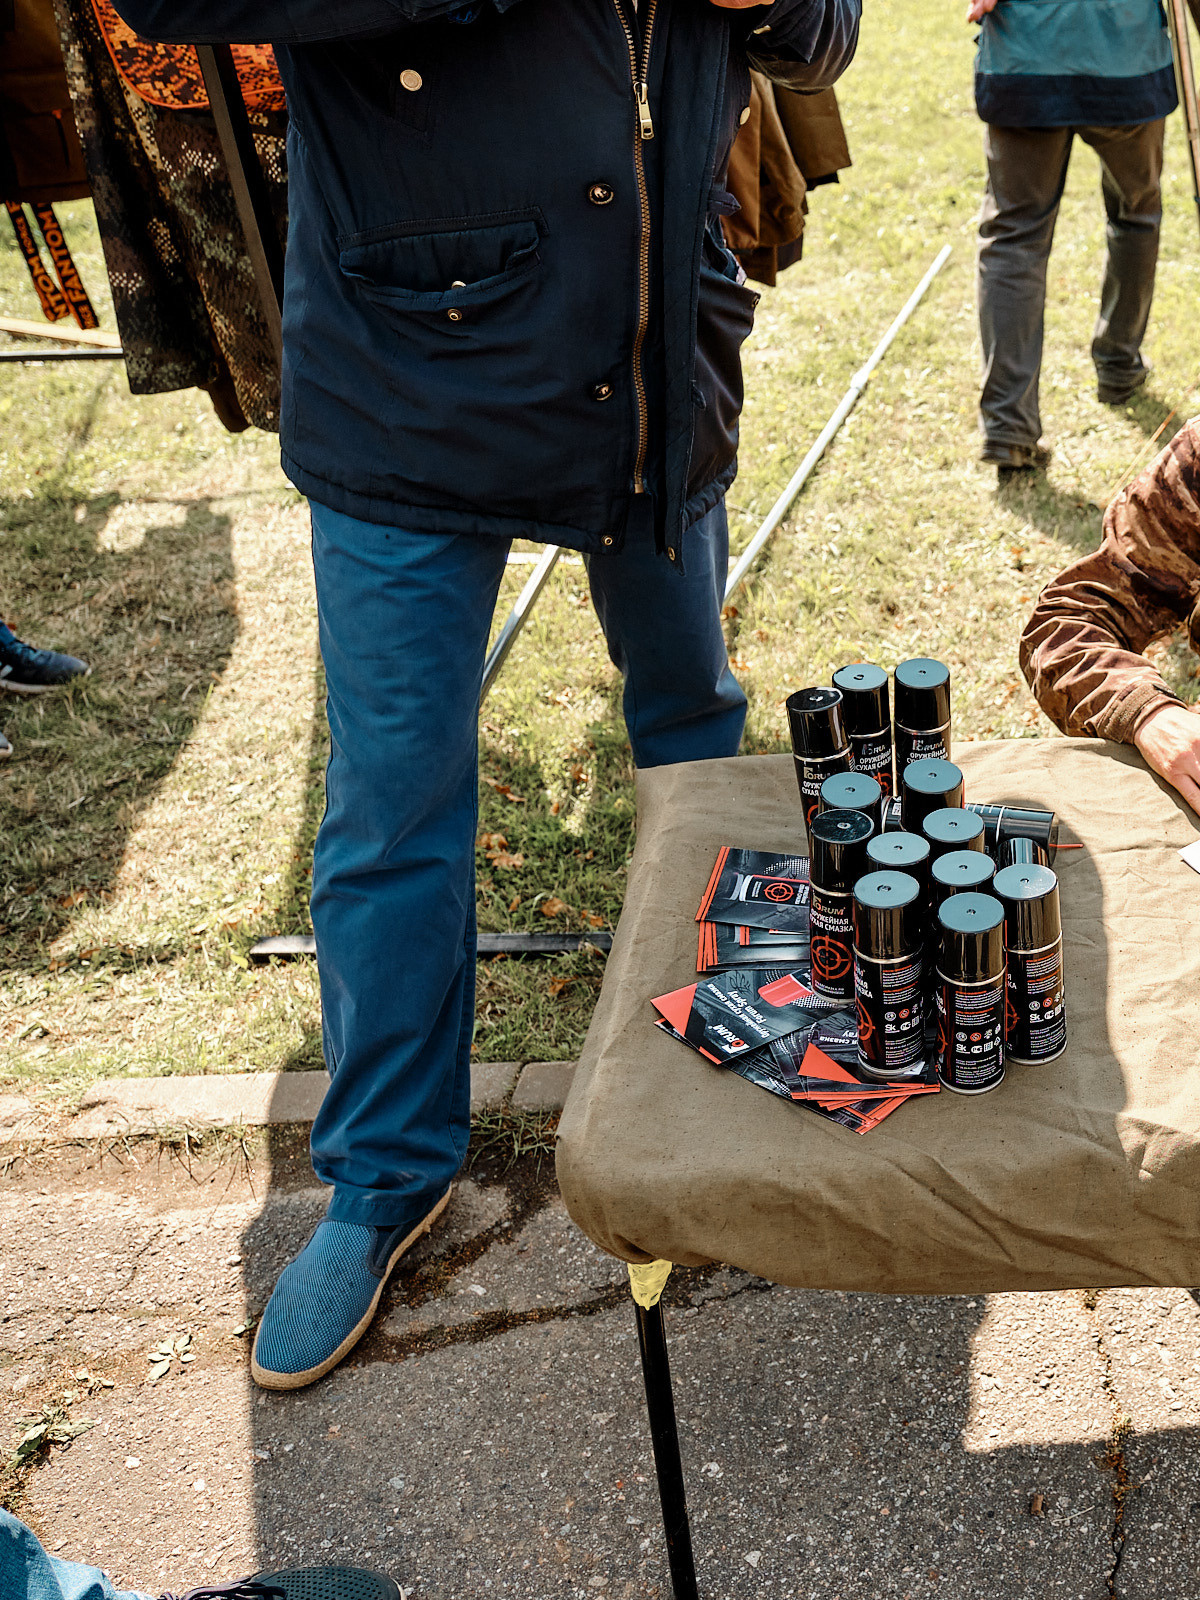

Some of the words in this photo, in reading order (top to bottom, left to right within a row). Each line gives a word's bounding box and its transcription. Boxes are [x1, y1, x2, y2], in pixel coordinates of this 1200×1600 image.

[38, 209, 88, 303] FANTOM
[824, 923, 854, 933] СМАЗКА
[726, 990, 748, 1008] Spray
[744, 1005, 768, 1024] Forum
[711, 1024, 751, 1054] FORUM
[842, 1030, 858, 1038] ray
